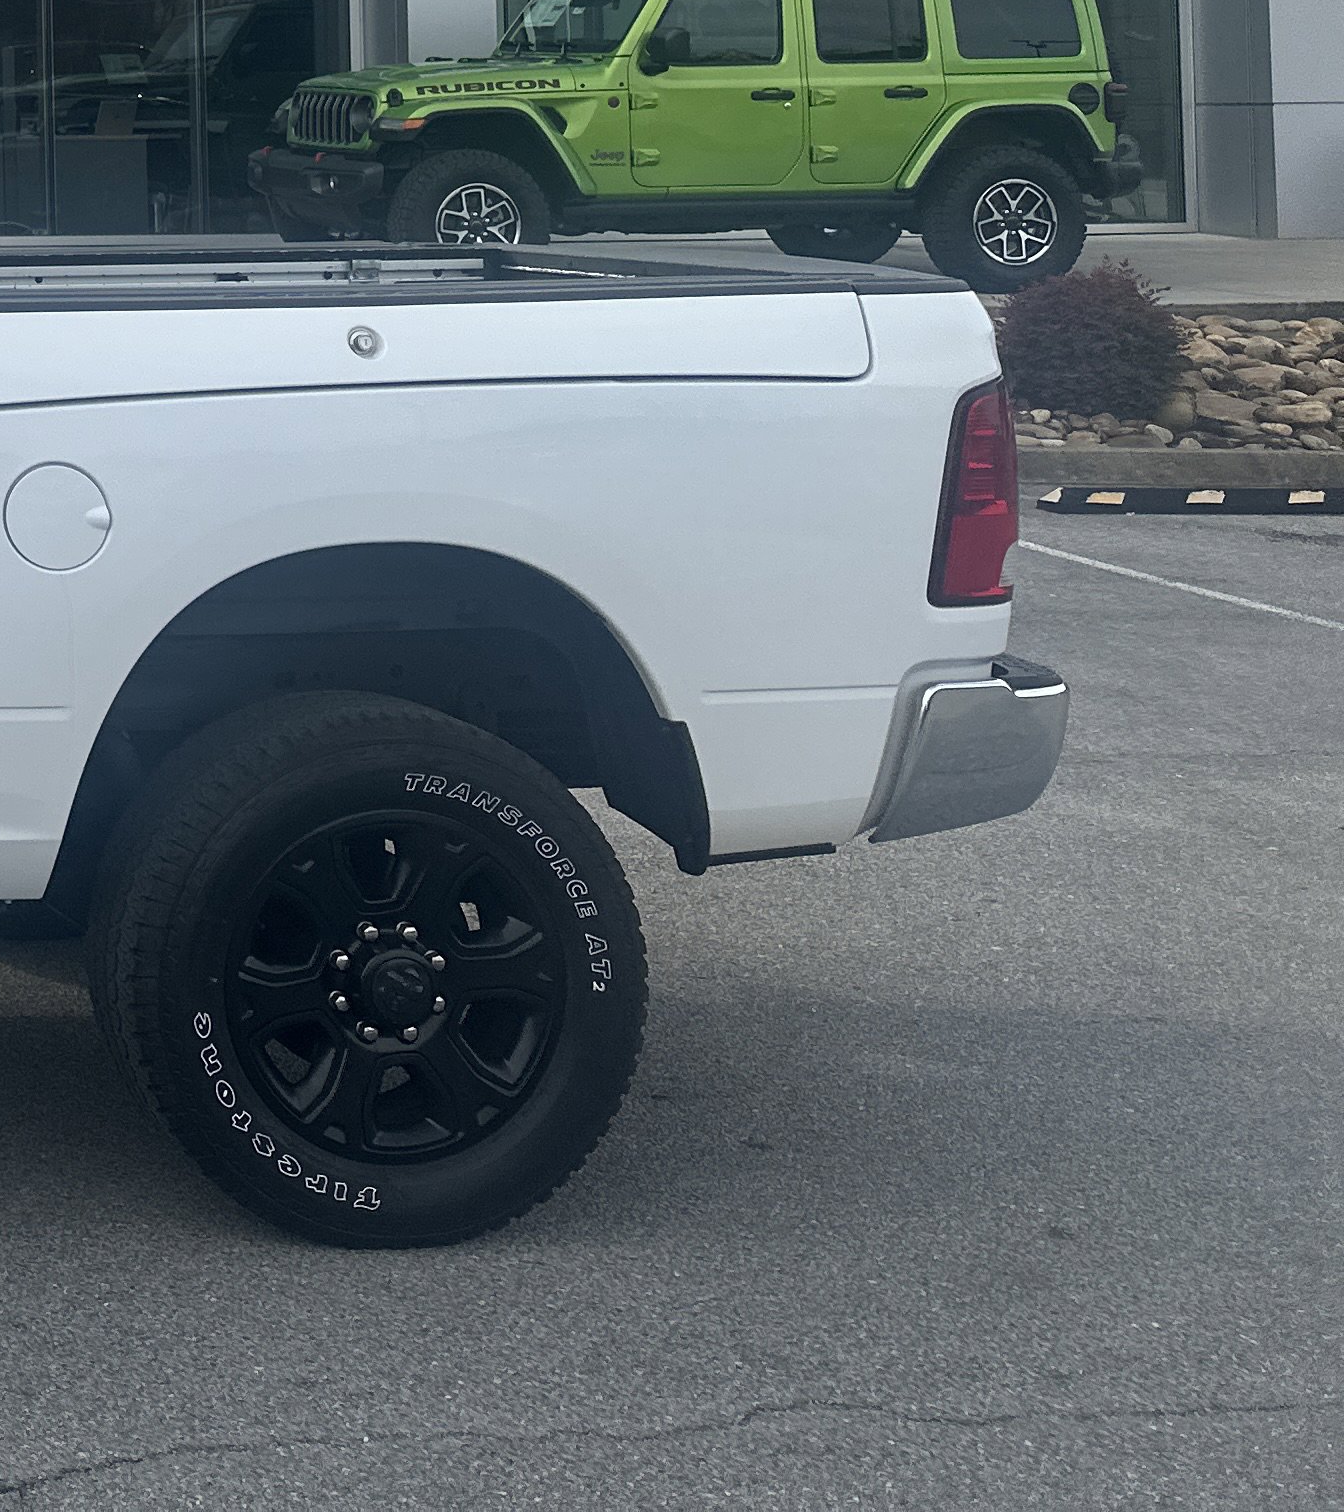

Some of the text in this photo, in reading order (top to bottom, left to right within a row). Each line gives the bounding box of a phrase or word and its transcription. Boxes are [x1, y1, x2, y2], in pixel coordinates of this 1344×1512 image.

[415, 78, 561, 96] RUBICON
[404, 772, 598, 919] TRANSFORCE
[193, 1011, 381, 1211] Firestone
